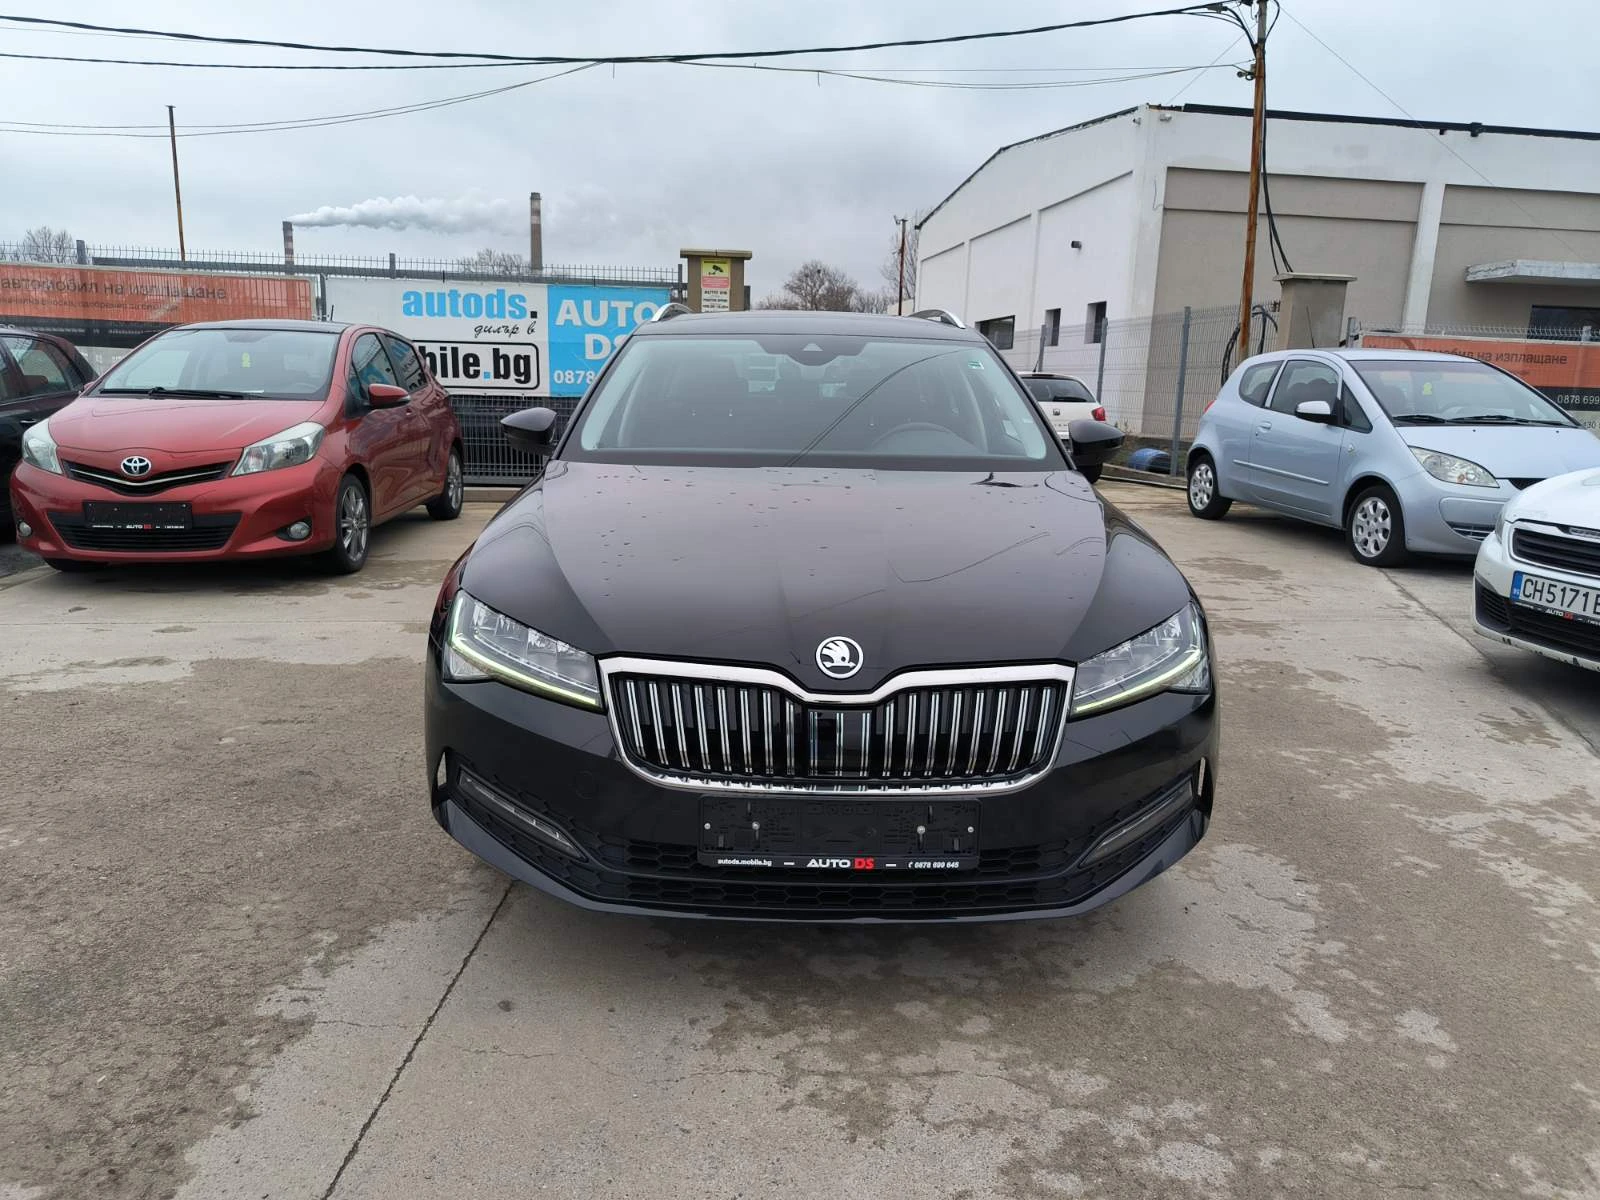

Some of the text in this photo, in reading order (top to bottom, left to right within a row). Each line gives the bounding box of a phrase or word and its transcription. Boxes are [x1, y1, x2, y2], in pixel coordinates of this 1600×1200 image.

[103, 282, 124, 295] на
[402, 288, 538, 320] autods.
[555, 299, 661, 327] AUTO
[1496, 352, 1568, 364] изплащане
[1557, 394, 1600, 405] 0878 699
[806, 858, 852, 868] AUTO
[854, 858, 875, 869] DS
